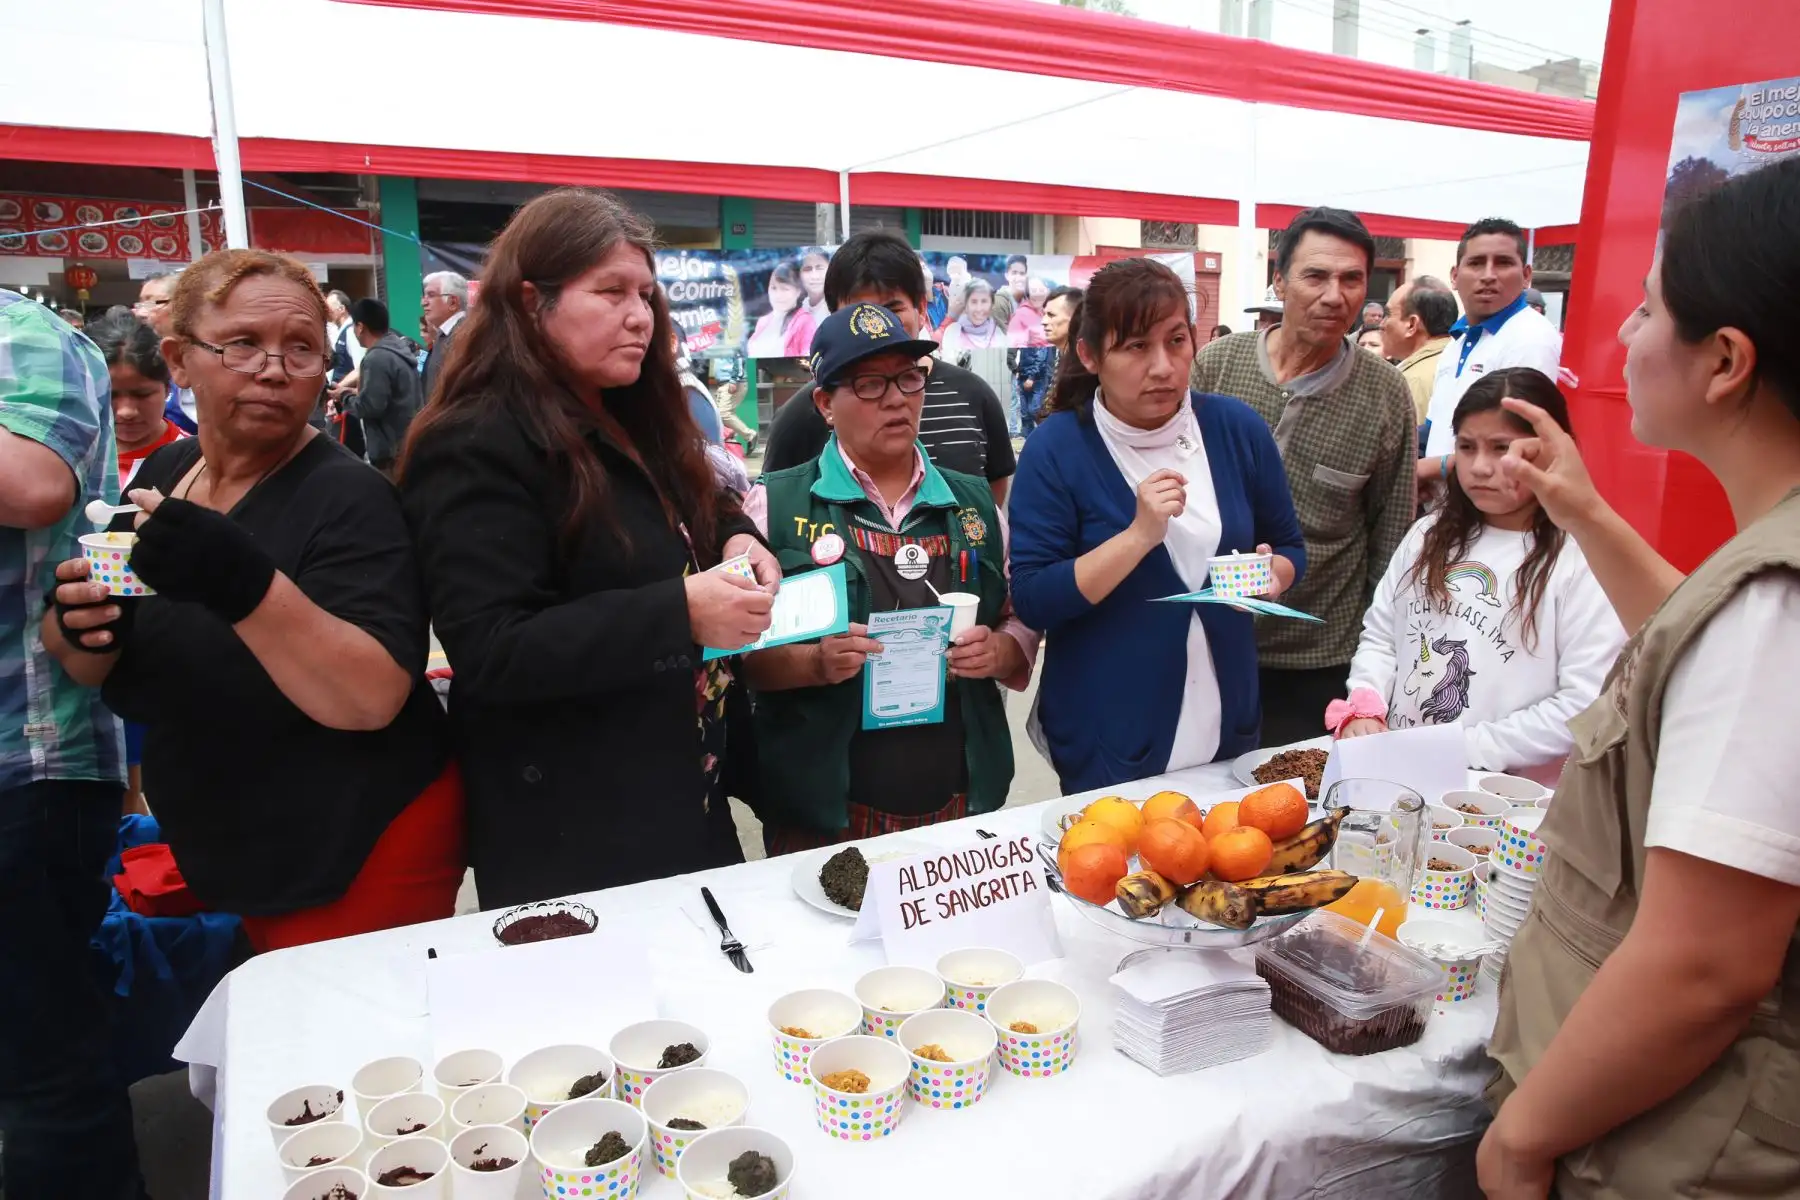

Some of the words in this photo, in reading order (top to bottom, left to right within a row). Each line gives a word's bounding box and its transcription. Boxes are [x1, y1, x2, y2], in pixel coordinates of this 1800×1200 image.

[1751, 89, 1765, 106] El
[1738, 103, 1784, 123] equipo
[1746, 122, 1759, 135] la
[668, 281, 734, 301] contra
[873, 614, 918, 624] Recetario
[1500, 650, 1515, 664] A
[899, 837, 1034, 896] ALBONDIGAS
[900, 897, 931, 930] DE
[937, 870, 1037, 920] SANGRITA
